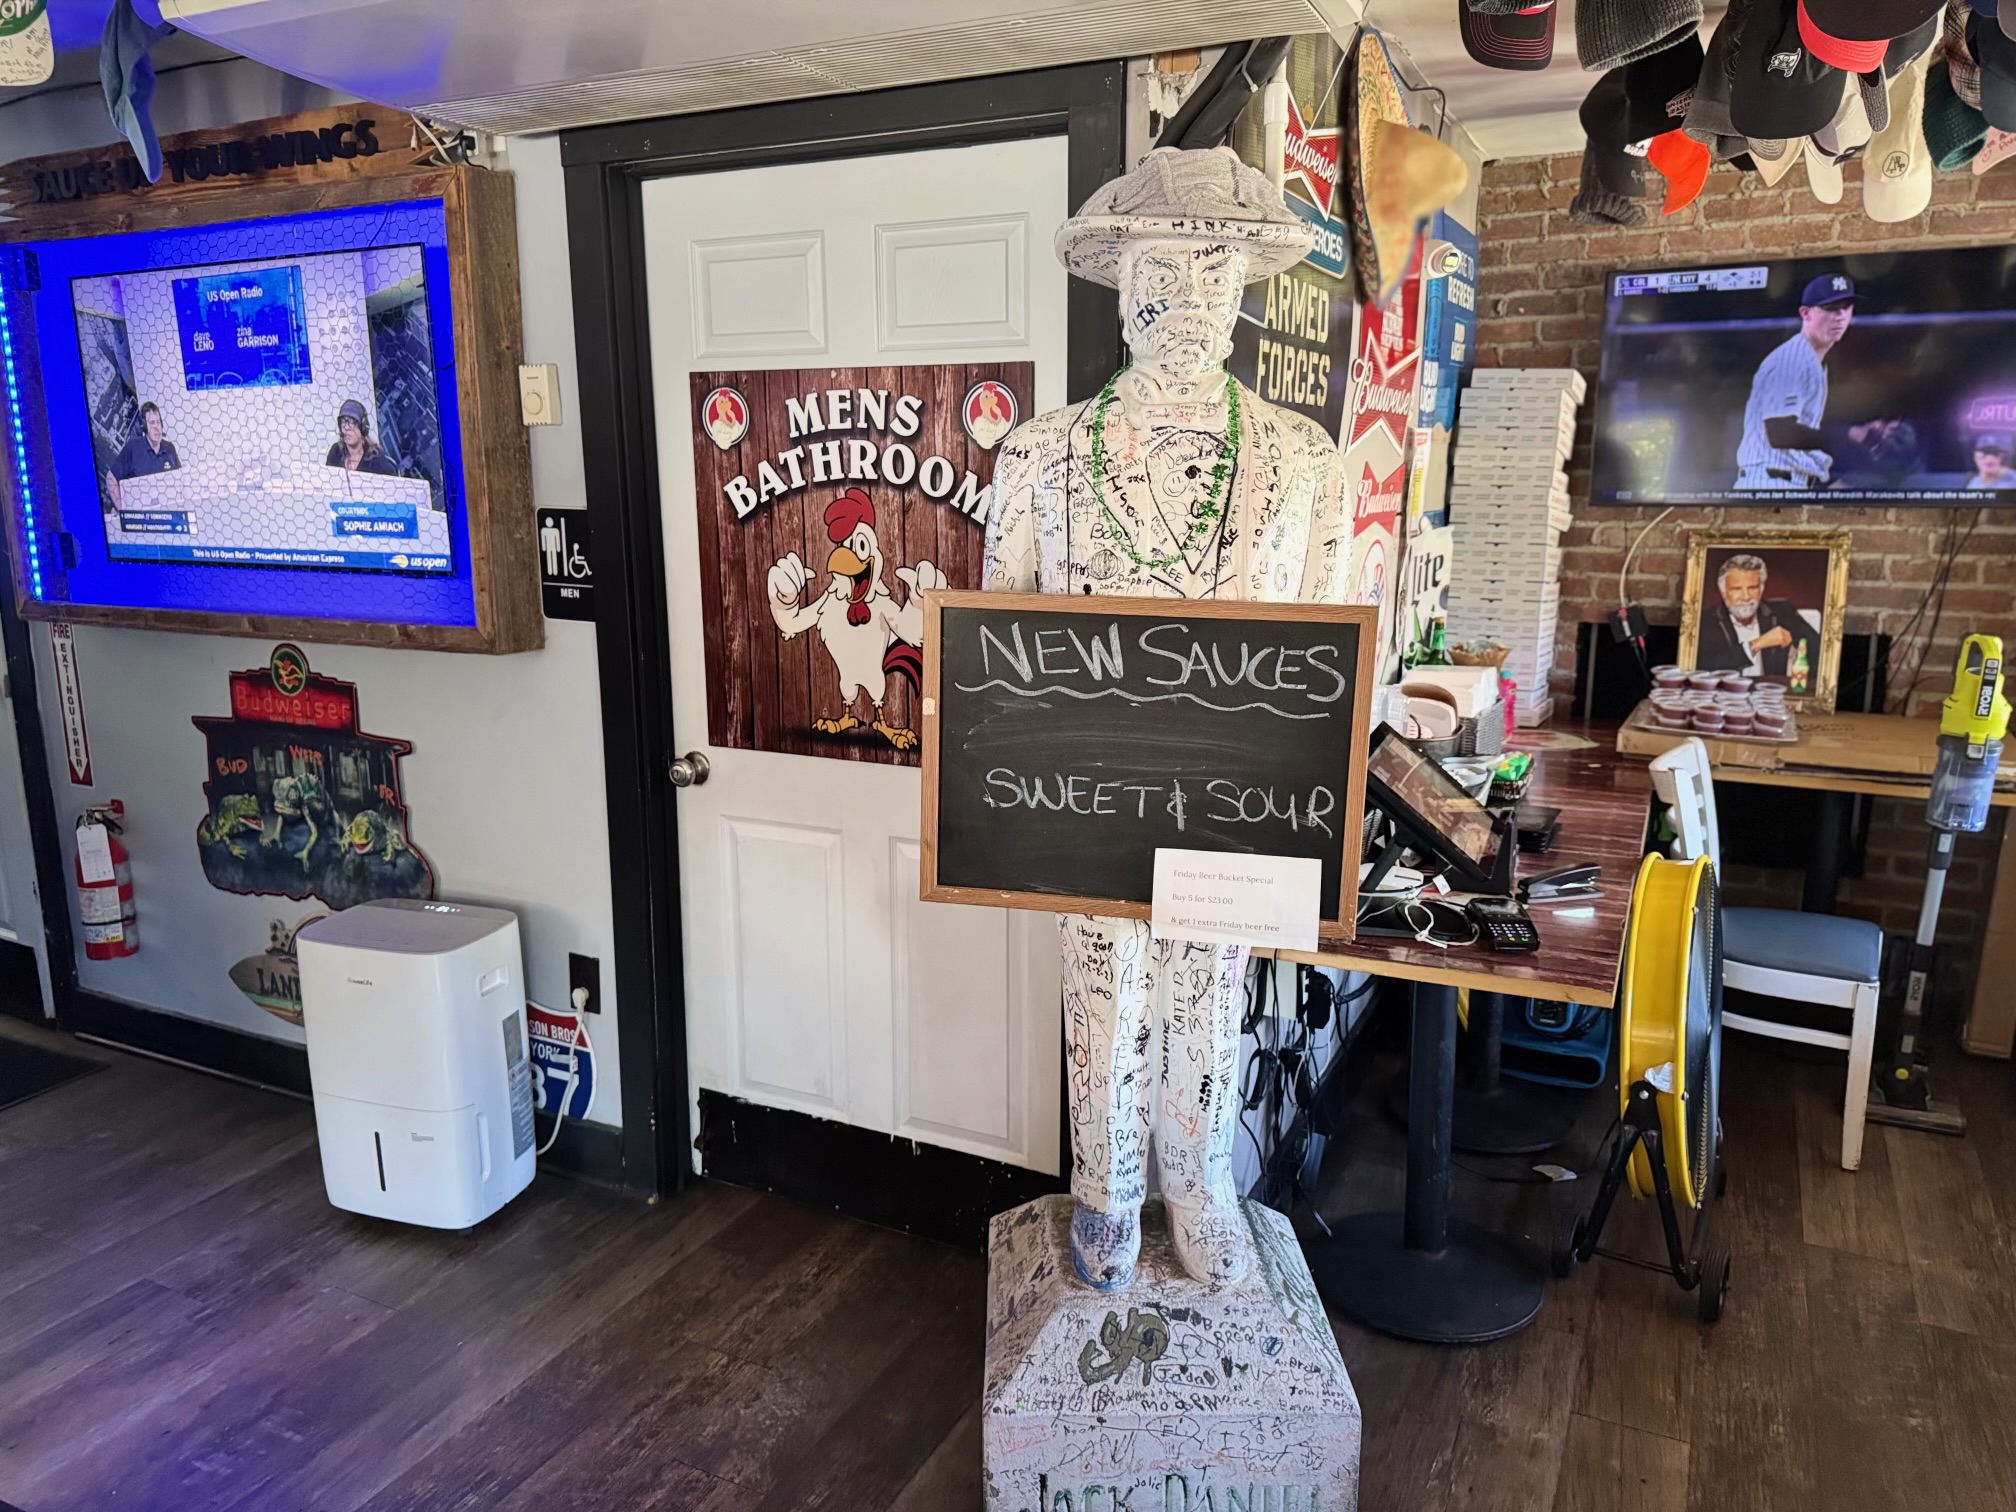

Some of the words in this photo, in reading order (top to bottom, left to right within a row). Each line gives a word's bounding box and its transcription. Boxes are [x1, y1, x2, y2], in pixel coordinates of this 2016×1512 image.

[30, 161, 113, 202] SAUCE
[117, 155, 153, 190] U
[165, 143, 250, 184] YOUR
[260, 119, 380, 170] WINGS
[1705, 274, 1711, 282] 4
[207, 290, 218, 302] US
[220, 290, 240, 302] Open
[241, 286, 263, 299] Radio
[1264, 273, 1330, 344] ARMED
[1447, 276, 1475, 312] REFRESH
[193, 340, 215, 352] LENO
[237, 334, 279, 348] GARRISON
[1256, 338, 1331, 409] FORCES
[1352, 358, 1415, 421] Budweiser
[785, 387, 923, 439] MENS
[723, 439, 992, 526] BATHROOM
[1818, 491, 1831, 499] and
[1922, 491, 1943, 499] about
[1944, 491, 1957, 499] the
[1357, 479, 1401, 518] Budweiser
[343, 520, 373, 532] SOPHIE
[373, 521, 405, 532] AMIACH
[211, 550, 220, 558] US
[221, 550, 234, 560] Open
[235, 551, 250, 560] Radio
[292, 553, 320, 562] American
[1413, 553, 1444, 600] lite
[560, 587, 580, 599] MEN
[53, 624, 71, 639] FIRE
[979, 621, 1124, 684] NEW
[1138, 623, 1346, 702] SAUCES
[60, 643, 83, 768] EXTINGUISHER
[235, 685, 351, 721] Budweiser
[1977, 685, 1993, 715] RYOBI
[984, 768, 1165, 819] SWEET
[1205, 780, 1335, 839] SOUR
[1173, 869, 1198, 880] Friday
[1199, 871, 1216, 881] Beer
[1218, 873, 1244, 883] Bucket
[1246, 875, 1274, 885] Special
[1172, 893, 1186, 903] Buy
[1188, 894, 1193, 902] 5
[1194, 895, 1206, 903] for
[1207, 896, 1234, 905] $23.00
[1178, 917, 1190, 926] get
[1219, 921, 1243, 931] Friday
[1244, 923, 1262, 931] beer
[1264, 924, 1280, 932] free
[551, 1026, 579, 1045] BROS.
